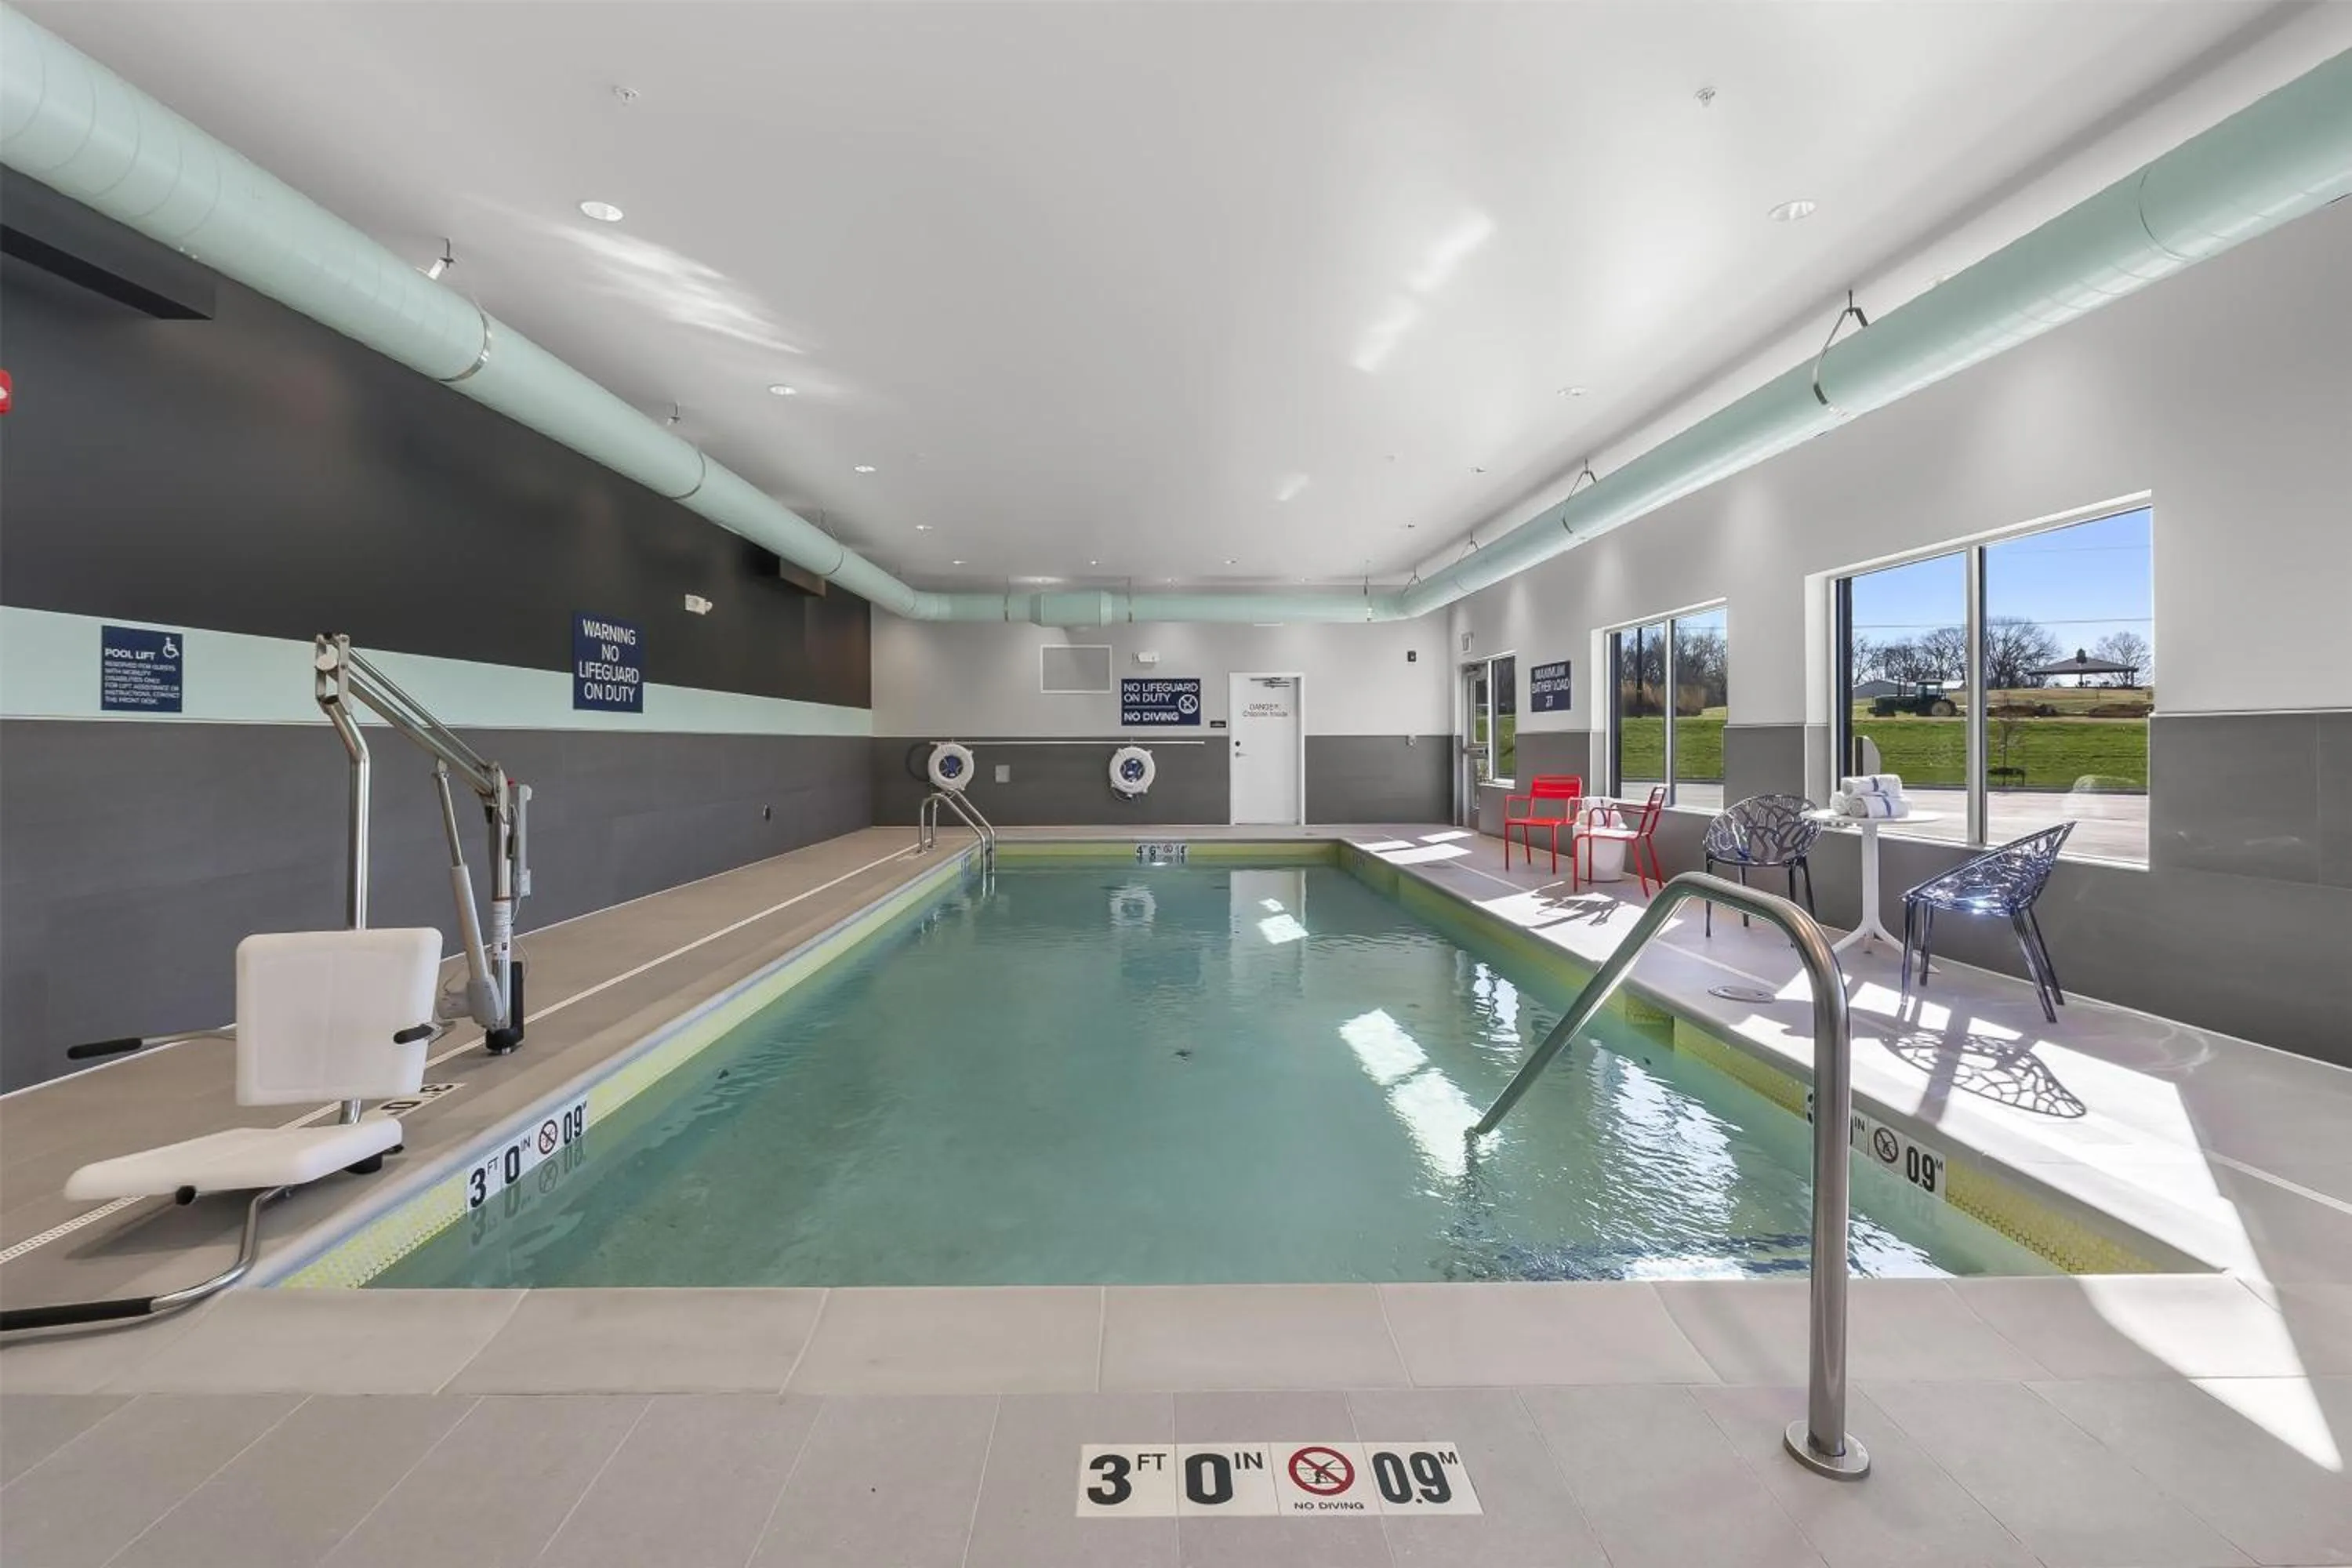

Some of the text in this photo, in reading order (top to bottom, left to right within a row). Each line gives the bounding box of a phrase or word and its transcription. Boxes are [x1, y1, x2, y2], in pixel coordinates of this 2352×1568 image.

[583, 618, 636, 645] WARNING
[104, 647, 156, 661] POOL LIFT
[601, 644, 620, 662] NO
[579, 660, 640, 684] LIFEGUARD
[584, 681, 636, 703] ON DUTY
[1123, 683, 1199, 692] NO LIFEGUARD
[1123, 692, 1171, 703] ON DUTY
[1123, 711, 1180, 721] NO DIVING
[1854, 1115, 1866, 1133] IN
[470, 1167, 487, 1208] 3
[487, 1156, 499, 1175] FT
[504, 1145, 521, 1185] 0
[520, 1134, 532, 1152] IN
[1087, 1450, 1458, 1506] 3 FT 0 IN 0.9 M
[1294, 1501, 1365, 1511] NO DIVING
